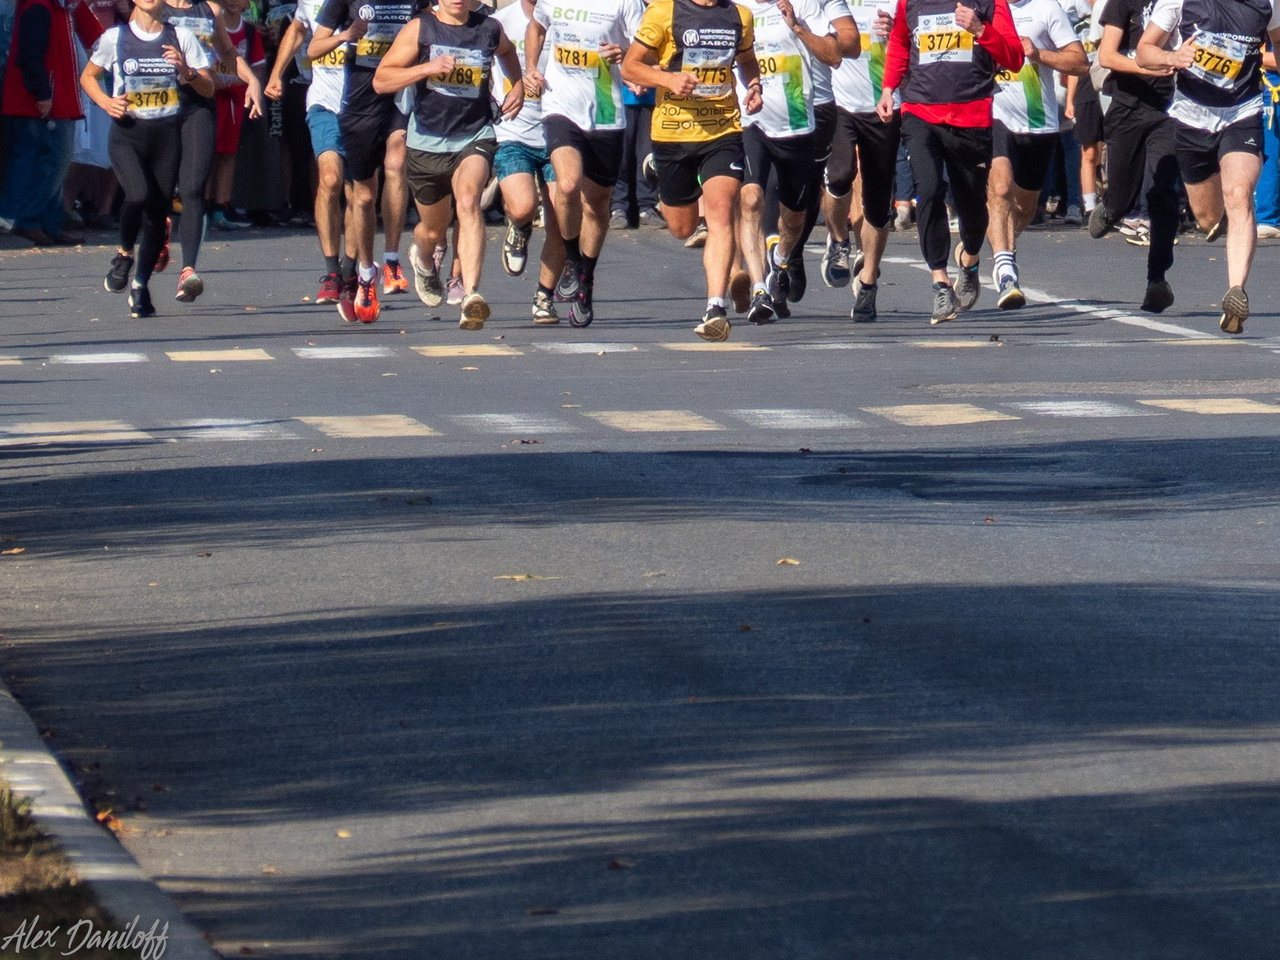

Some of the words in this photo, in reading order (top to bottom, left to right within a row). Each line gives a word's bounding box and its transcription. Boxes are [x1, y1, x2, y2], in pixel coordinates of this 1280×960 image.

[927, 31, 961, 51] 3771
[557, 47, 588, 67] 3781
[1194, 47, 1232, 76] 3776
[691, 66, 727, 84] 3775
[134, 90, 169, 108] 3770
